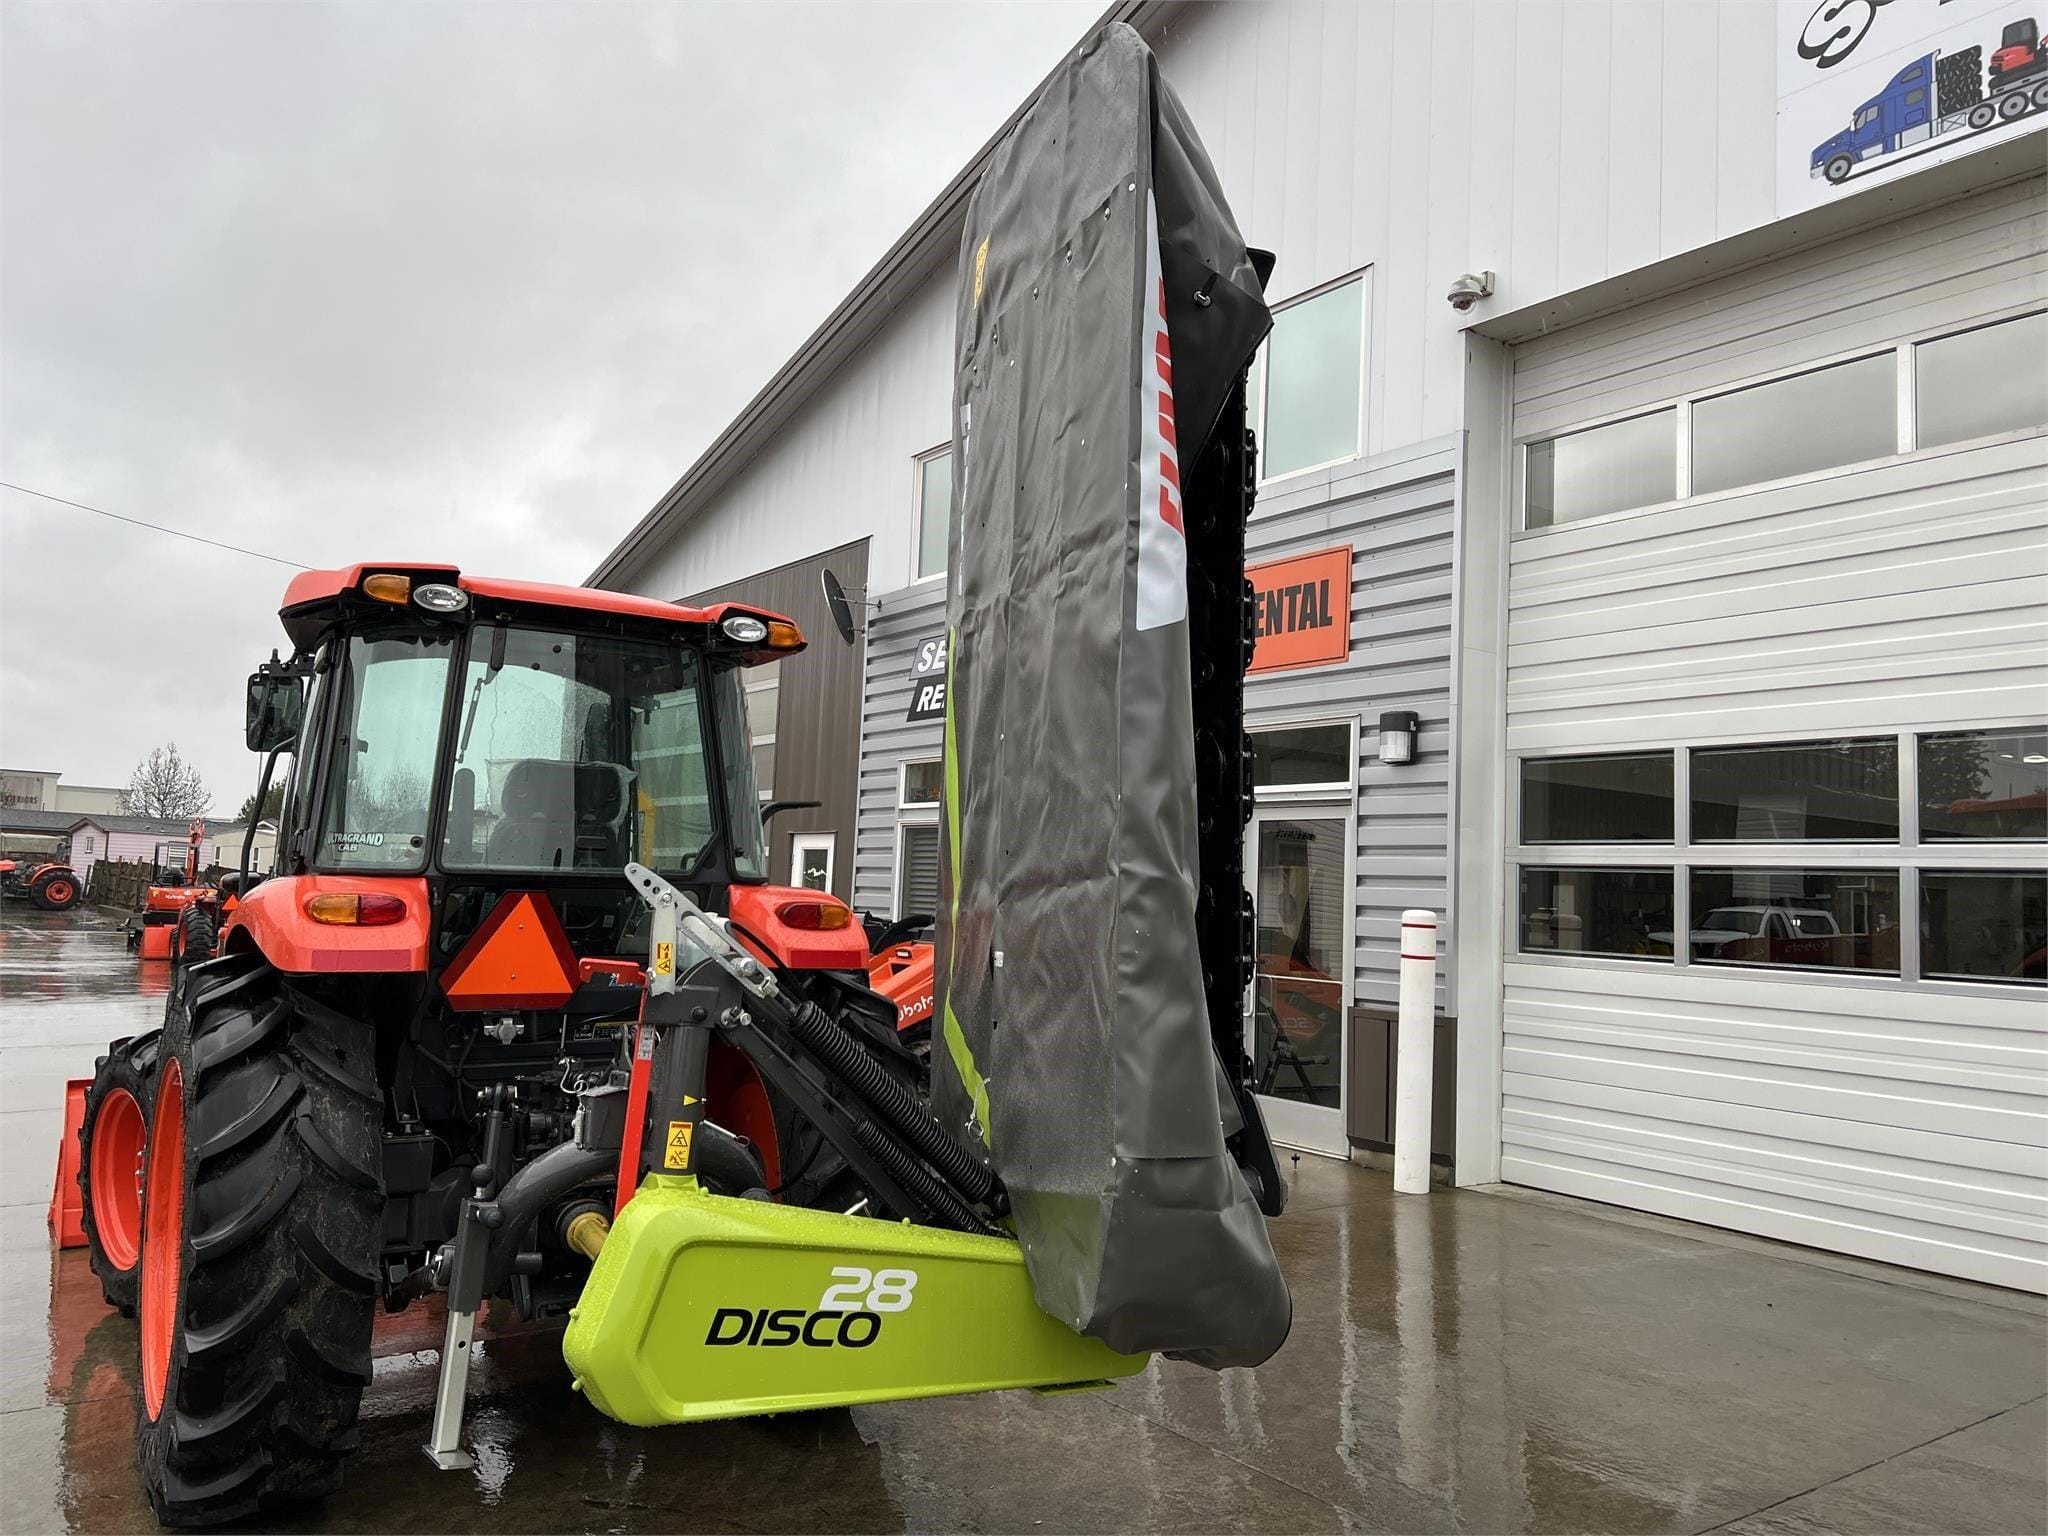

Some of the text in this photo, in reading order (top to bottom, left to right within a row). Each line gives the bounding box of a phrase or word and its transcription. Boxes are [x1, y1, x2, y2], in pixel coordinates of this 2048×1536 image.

[1254, 579, 1333, 638] ENTAL
[916, 684, 946, 712] RE
[338, 844, 358, 852] CAB
[899, 995, 934, 1021] ubota
[818, 1266, 918, 1313] 28
[705, 1308, 882, 1348] DISCO
